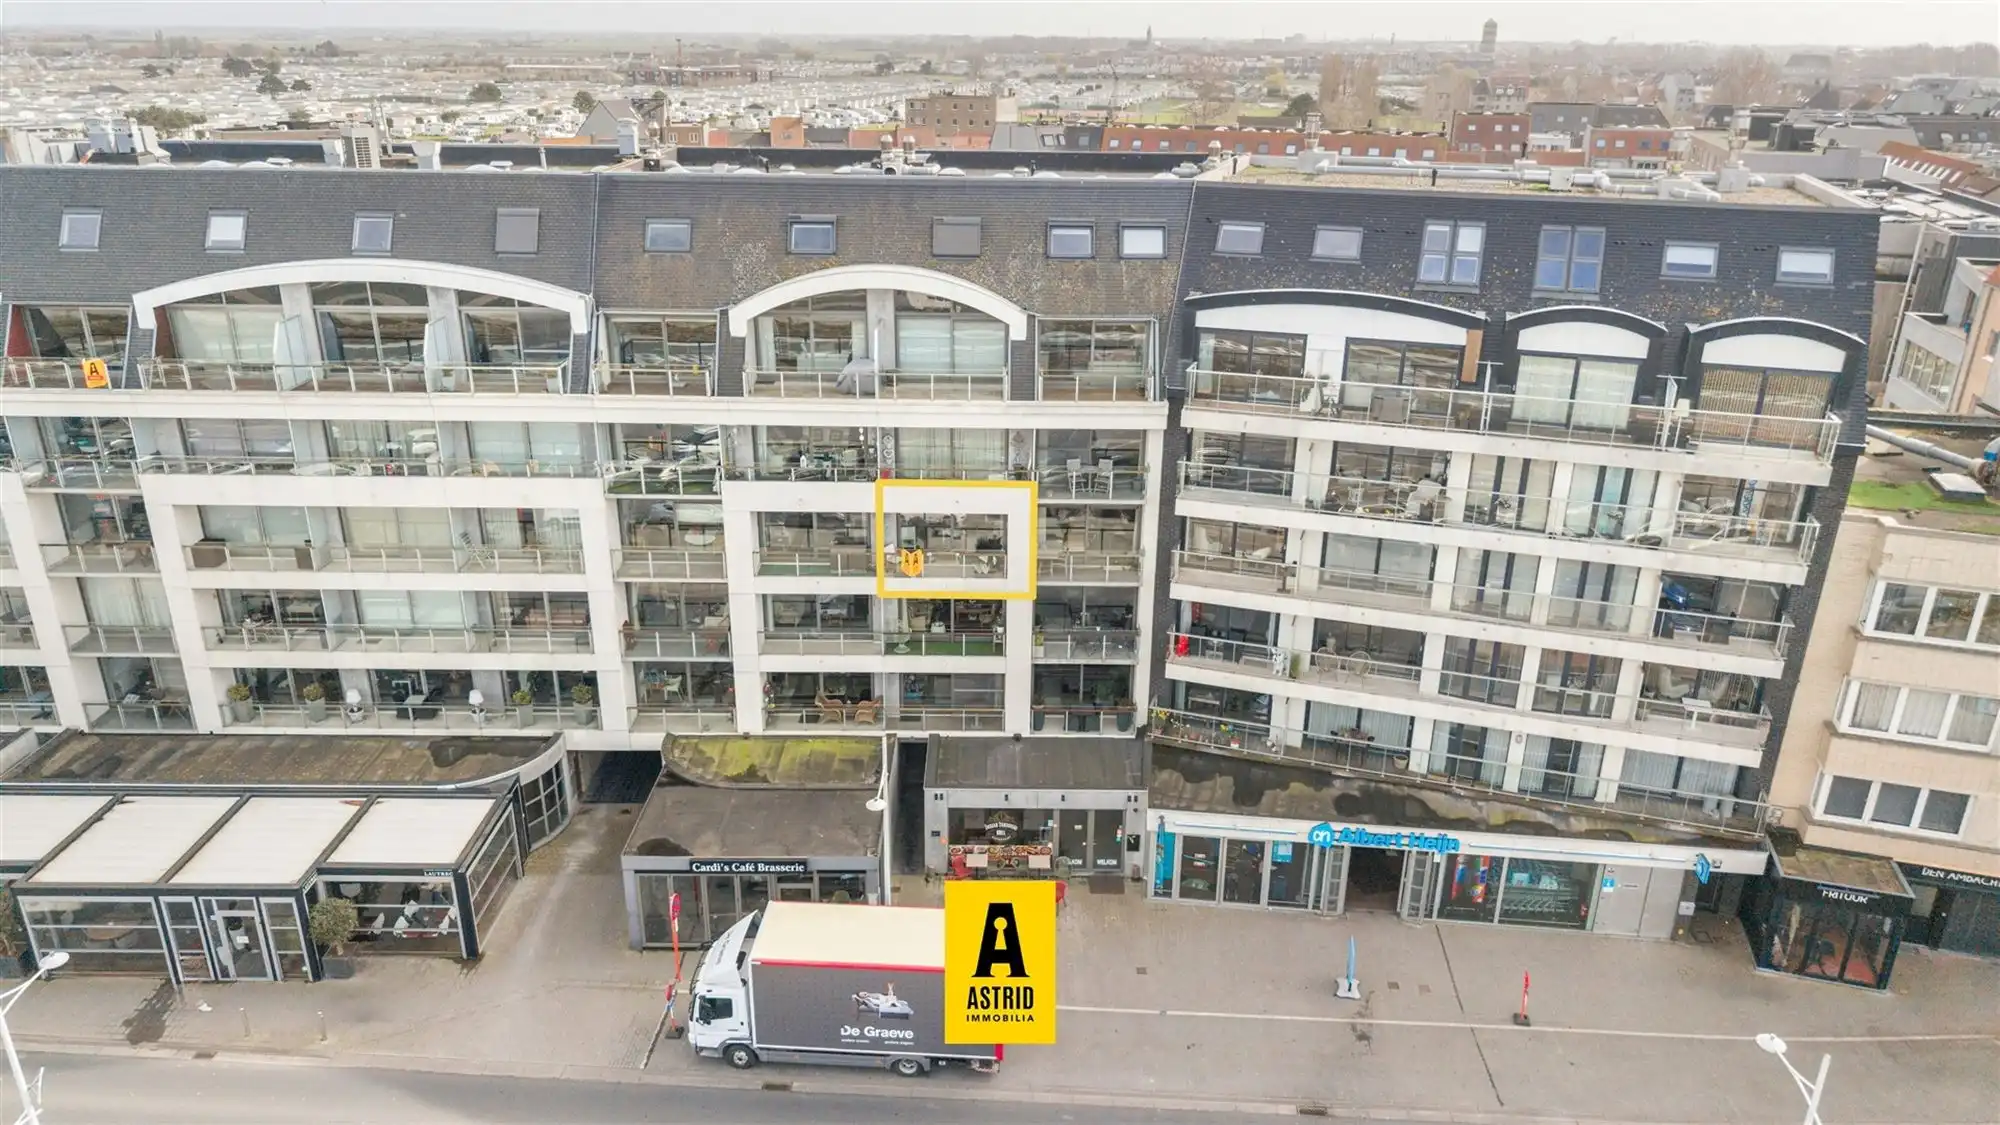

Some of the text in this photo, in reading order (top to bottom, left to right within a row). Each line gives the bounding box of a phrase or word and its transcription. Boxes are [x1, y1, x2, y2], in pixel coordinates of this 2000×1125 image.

[1339, 827, 1402, 849] Albert
[1409, 832, 1461, 855] Heijn
[692, 862, 805, 872] Cardi's Café Brasserie
[1921, 867, 2000, 888] DEN AMBACH
[840, 1025, 914, 1039] De Graeve
